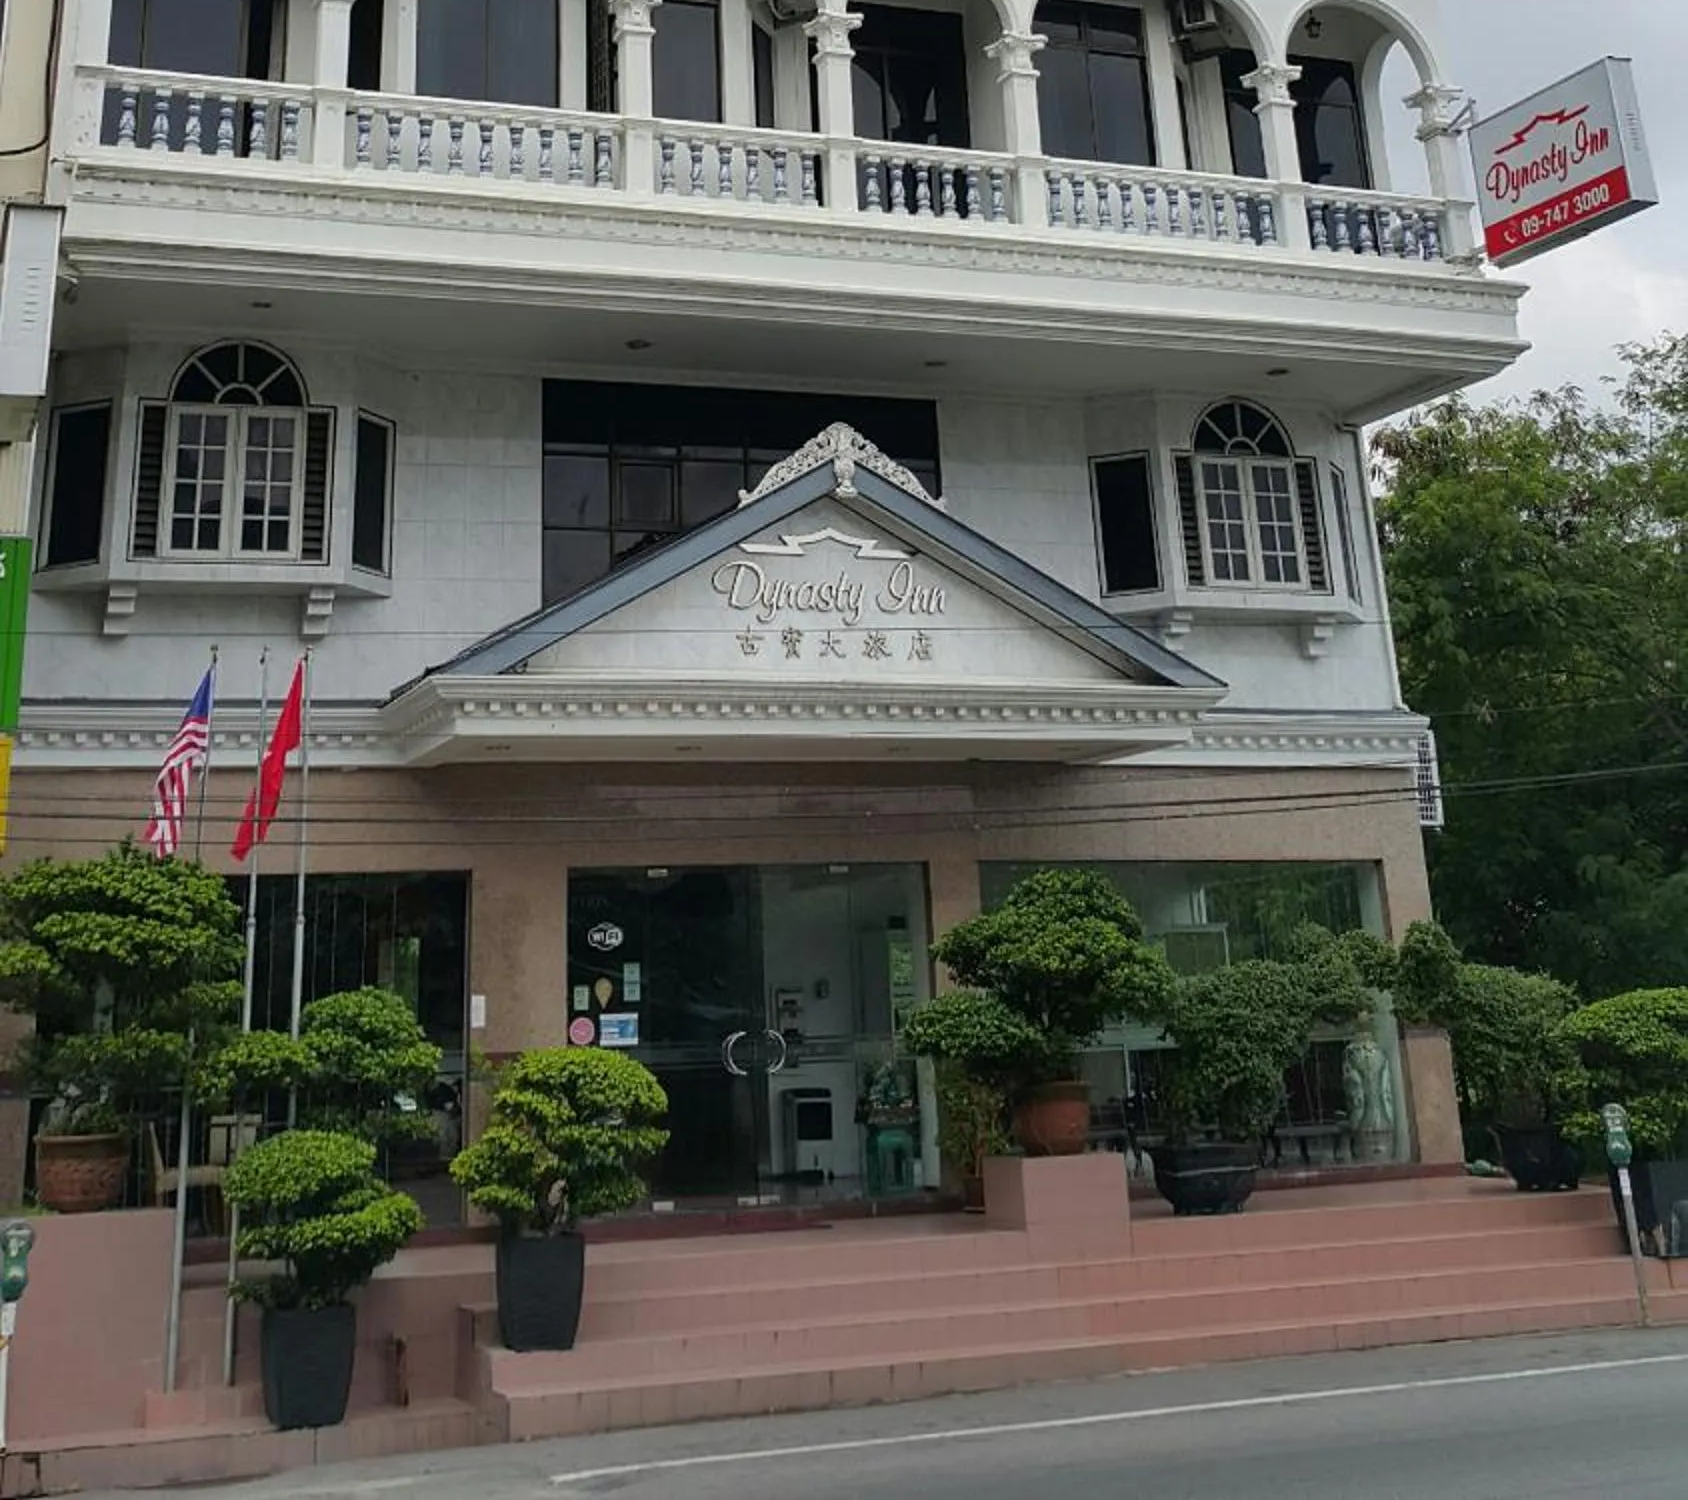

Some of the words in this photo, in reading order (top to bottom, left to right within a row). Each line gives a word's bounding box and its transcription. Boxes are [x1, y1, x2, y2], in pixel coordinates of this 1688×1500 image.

[1485, 143, 1568, 204] Dynasty
[1571, 119, 1609, 164] Inn
[1521, 202, 1569, 237] 09-747
[1573, 184, 1610, 215] 3000
[711, 560, 866, 626] Dynasty
[875, 561, 945, 613] Inn
